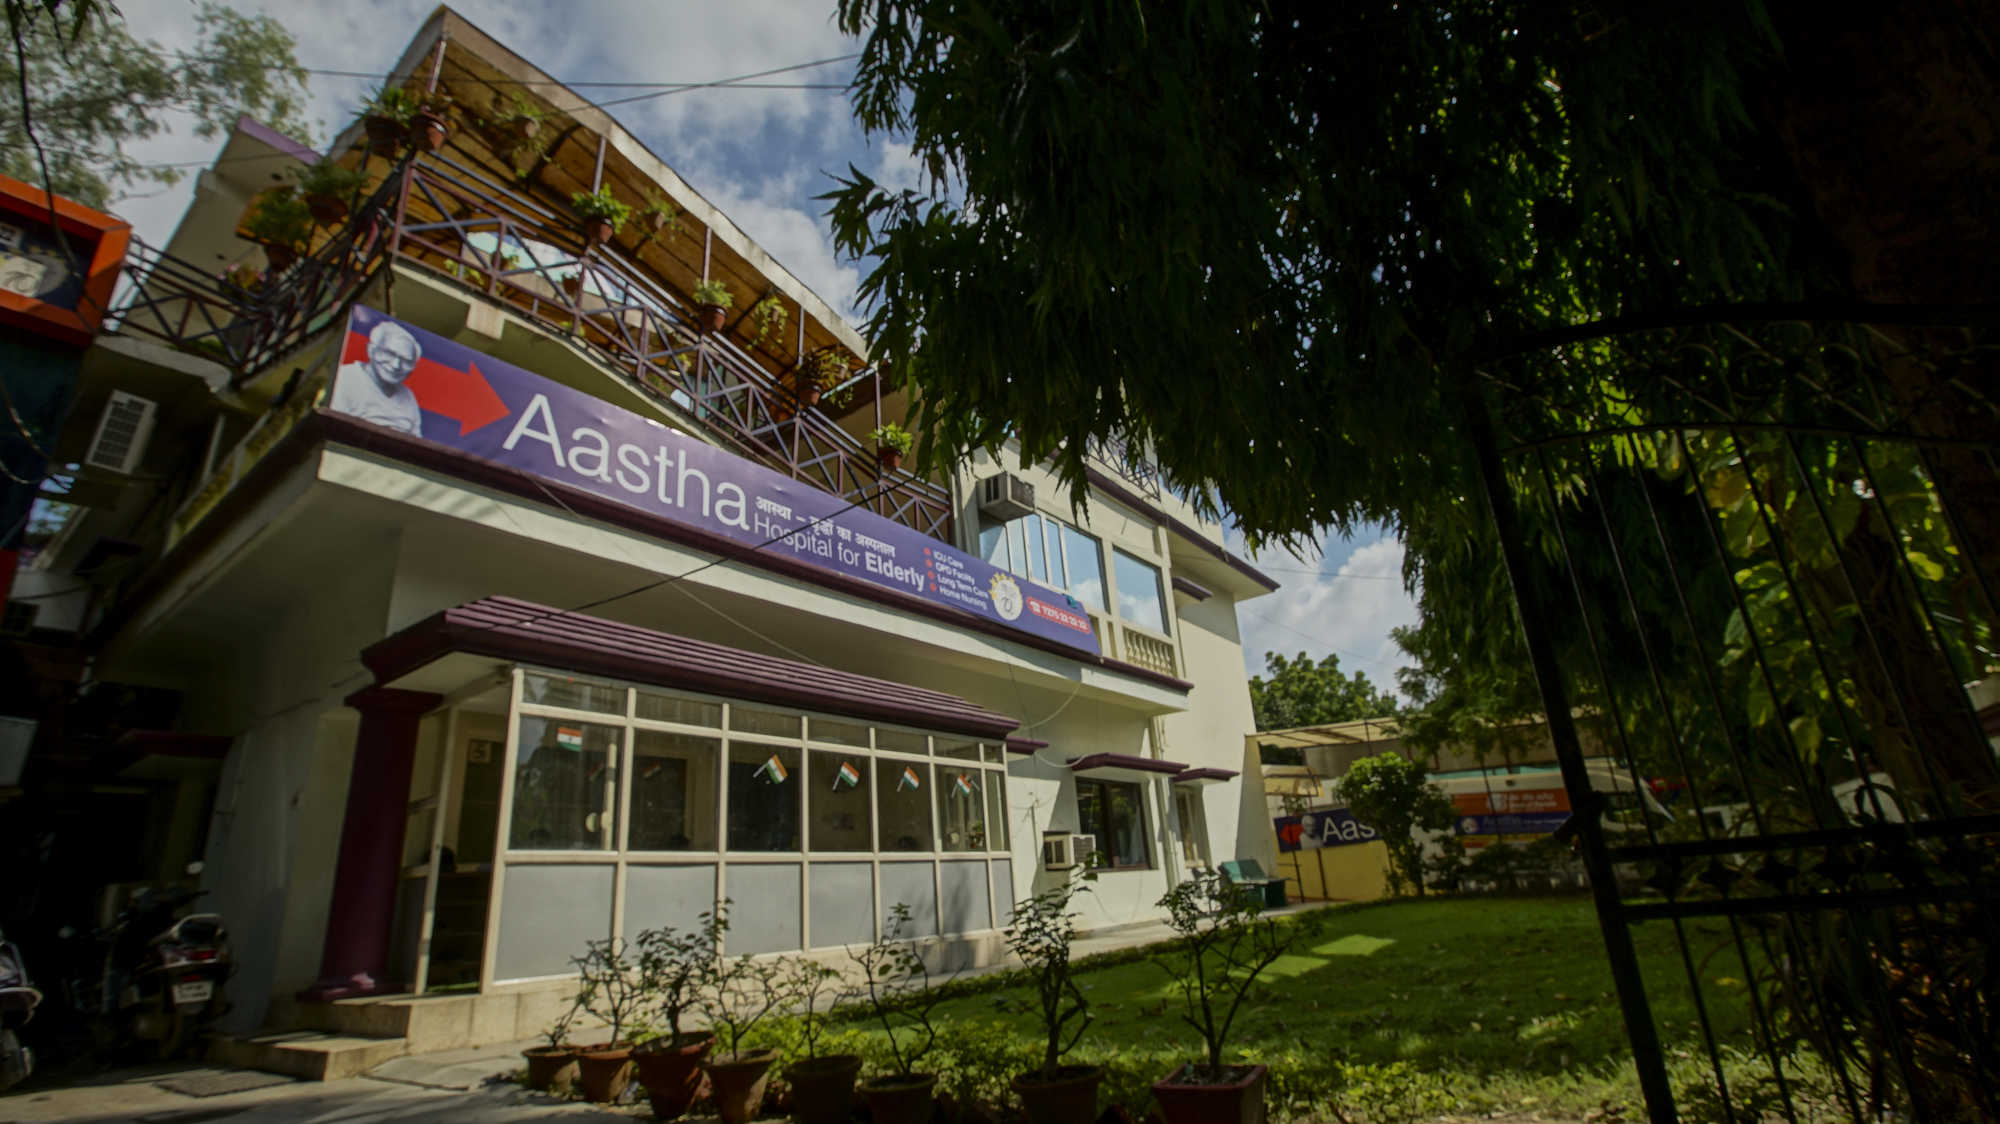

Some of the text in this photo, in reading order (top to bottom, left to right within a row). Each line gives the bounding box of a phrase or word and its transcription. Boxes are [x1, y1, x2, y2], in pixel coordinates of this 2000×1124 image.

[502, 394, 750, 533] Aastha
[754, 512, 926, 593] Hospital for Elderly
[937, 573, 989, 600] Long Term Care
[939, 585, 961, 600] Home
